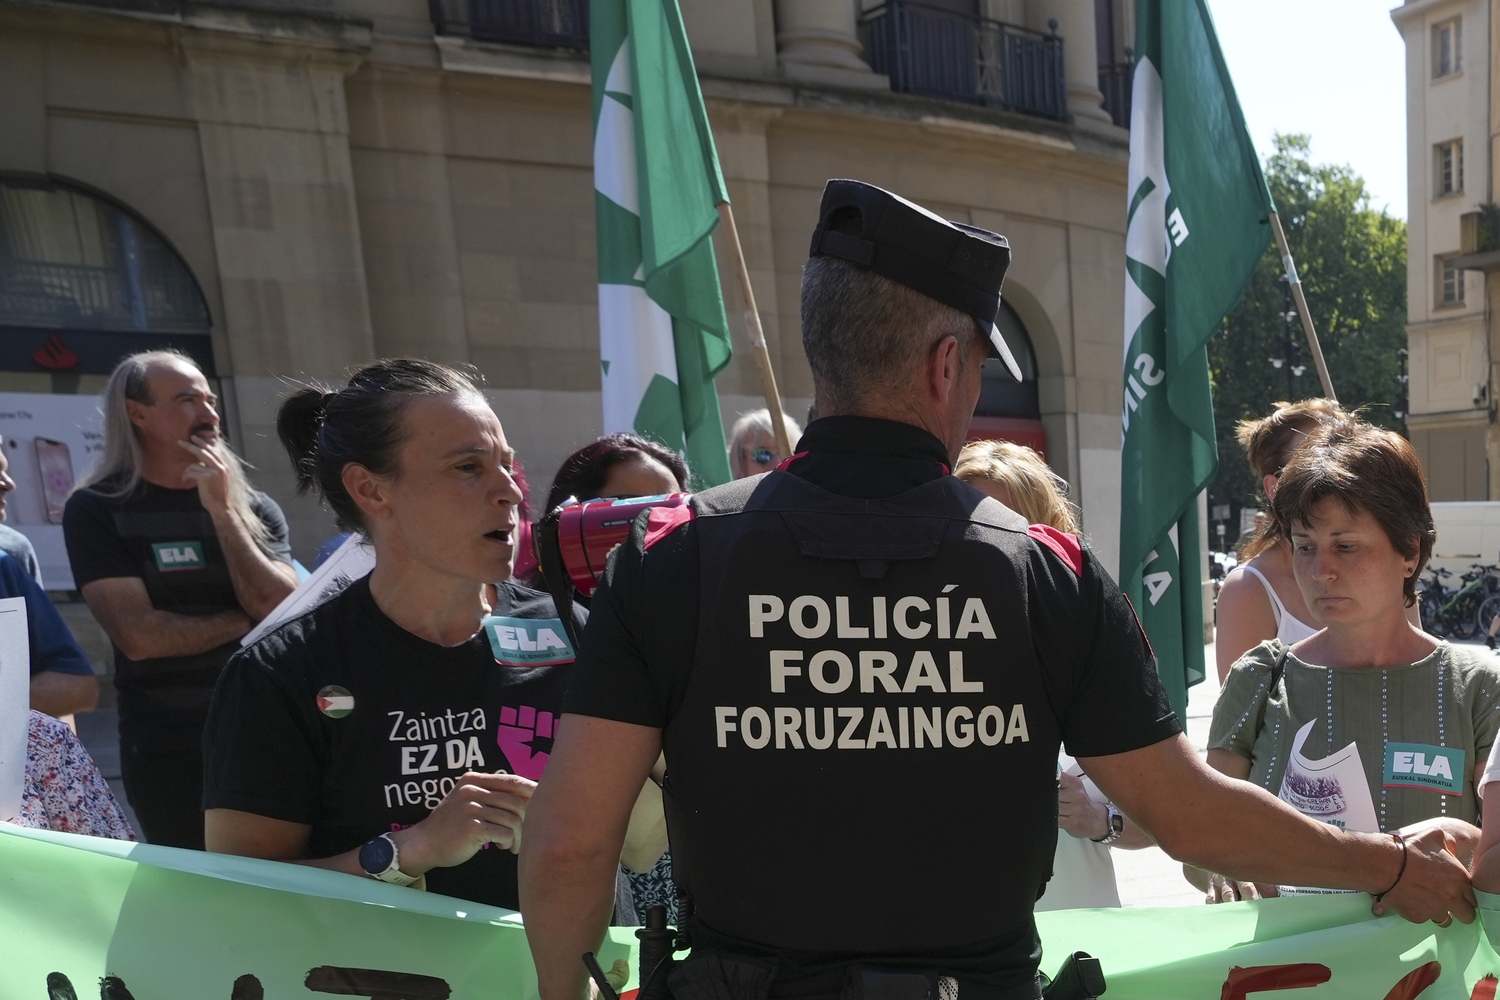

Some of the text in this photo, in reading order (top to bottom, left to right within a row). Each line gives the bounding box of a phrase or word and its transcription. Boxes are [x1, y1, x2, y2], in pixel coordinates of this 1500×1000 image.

[159, 547, 199, 563] ELA
[748, 584, 998, 640] POLICÍA
[494, 625, 567, 652] ELA
[502, 651, 526, 660] EUSKAL
[769, 650, 984, 694] FORAL
[387, 708, 487, 742] Zaintza
[715, 704, 1030, 750] FORUZAINGOA
[401, 736, 485, 775] EZ DA
[1393, 751, 1453, 780] ELA
[1417, 777, 1453, 788] SINDIKATUA
